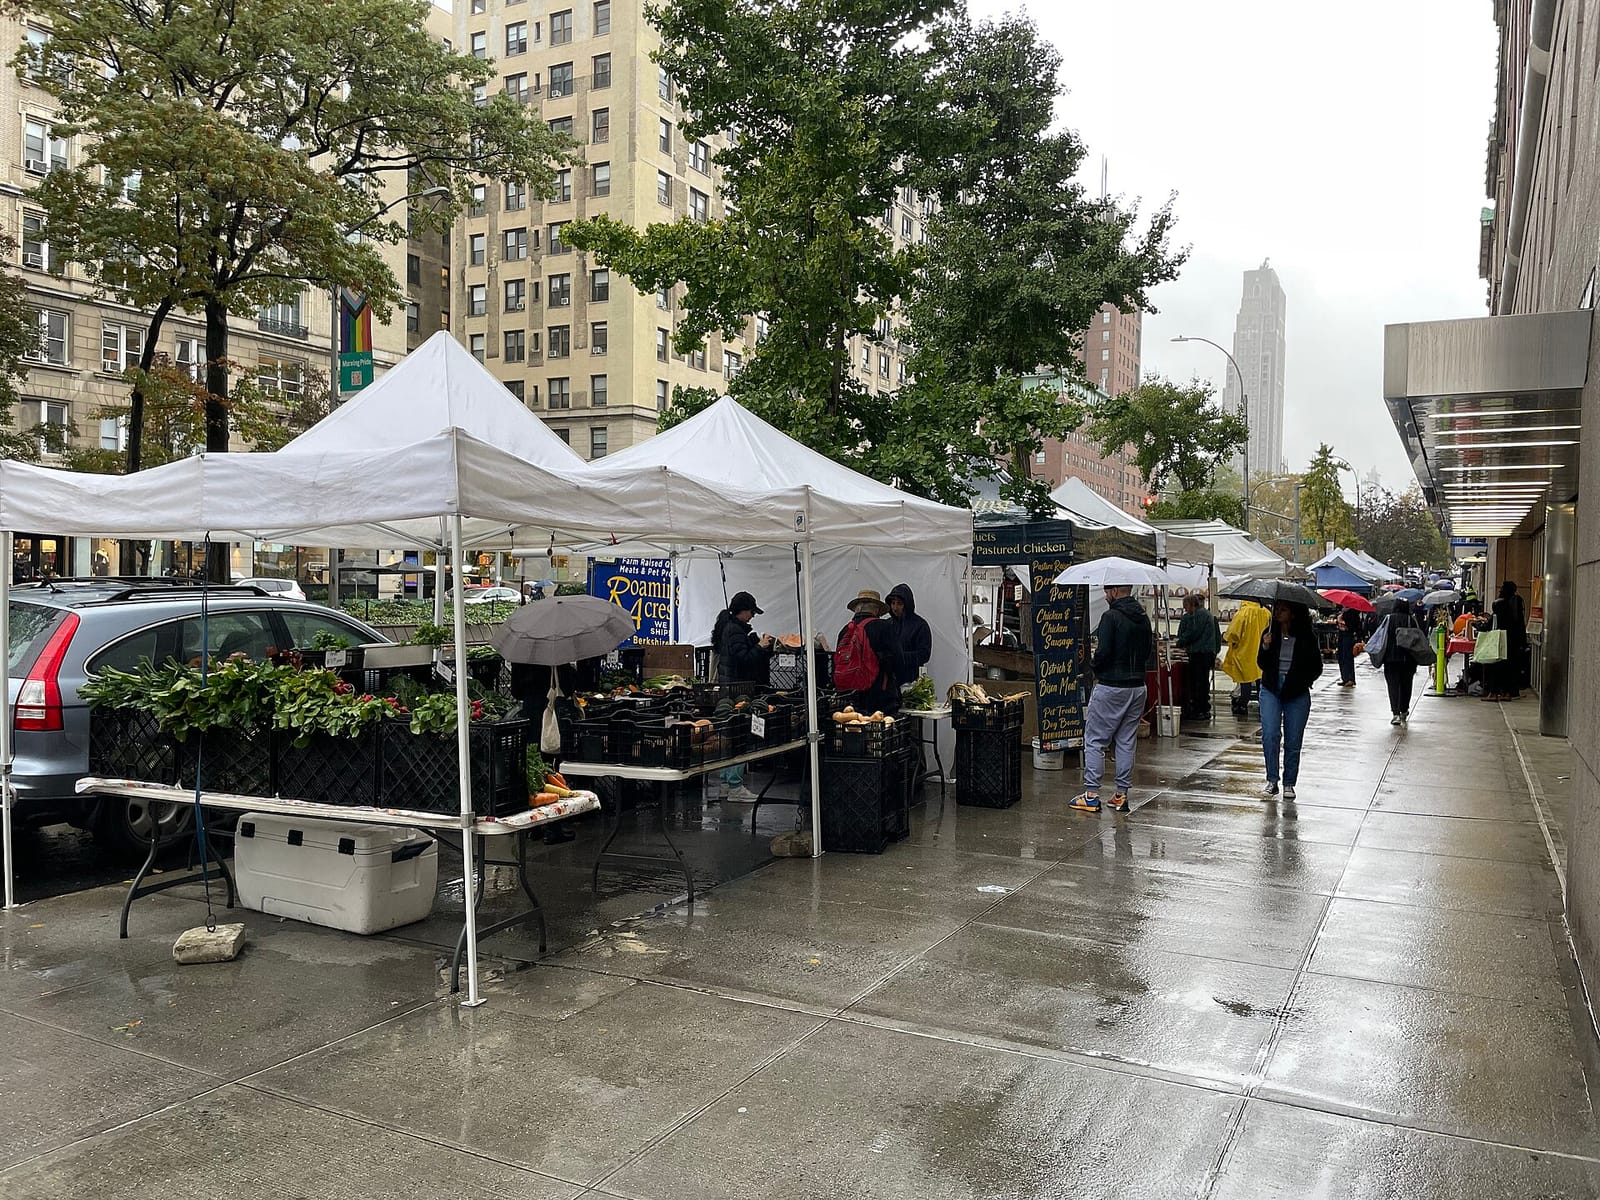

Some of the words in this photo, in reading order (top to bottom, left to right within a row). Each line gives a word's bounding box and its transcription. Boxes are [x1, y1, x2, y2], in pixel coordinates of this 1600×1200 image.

[976, 544, 1020, 555] Pastured
[1023, 542, 1066, 554] Chicken
[622, 557, 639, 566] Farm
[640, 558, 662, 568] Raised
[640, 567, 646, 575] &
[647, 567, 659, 576] Pet
[1049, 586, 1074, 602] Pork
[630, 597, 671, 630] Acres
[1036, 608, 1063, 624] Chicken
[654, 621, 667, 629] WE
[1041, 621, 1068, 636] Chicken
[1044, 634, 1074, 650] Sausage
[1040, 660, 1066, 678] Ostrich
[1039, 679, 1058, 697] Bison
[1059, 676, 1077, 696] Meat
[1042, 706, 1056, 719] Pet
[1056, 705, 1078, 717] Treats
